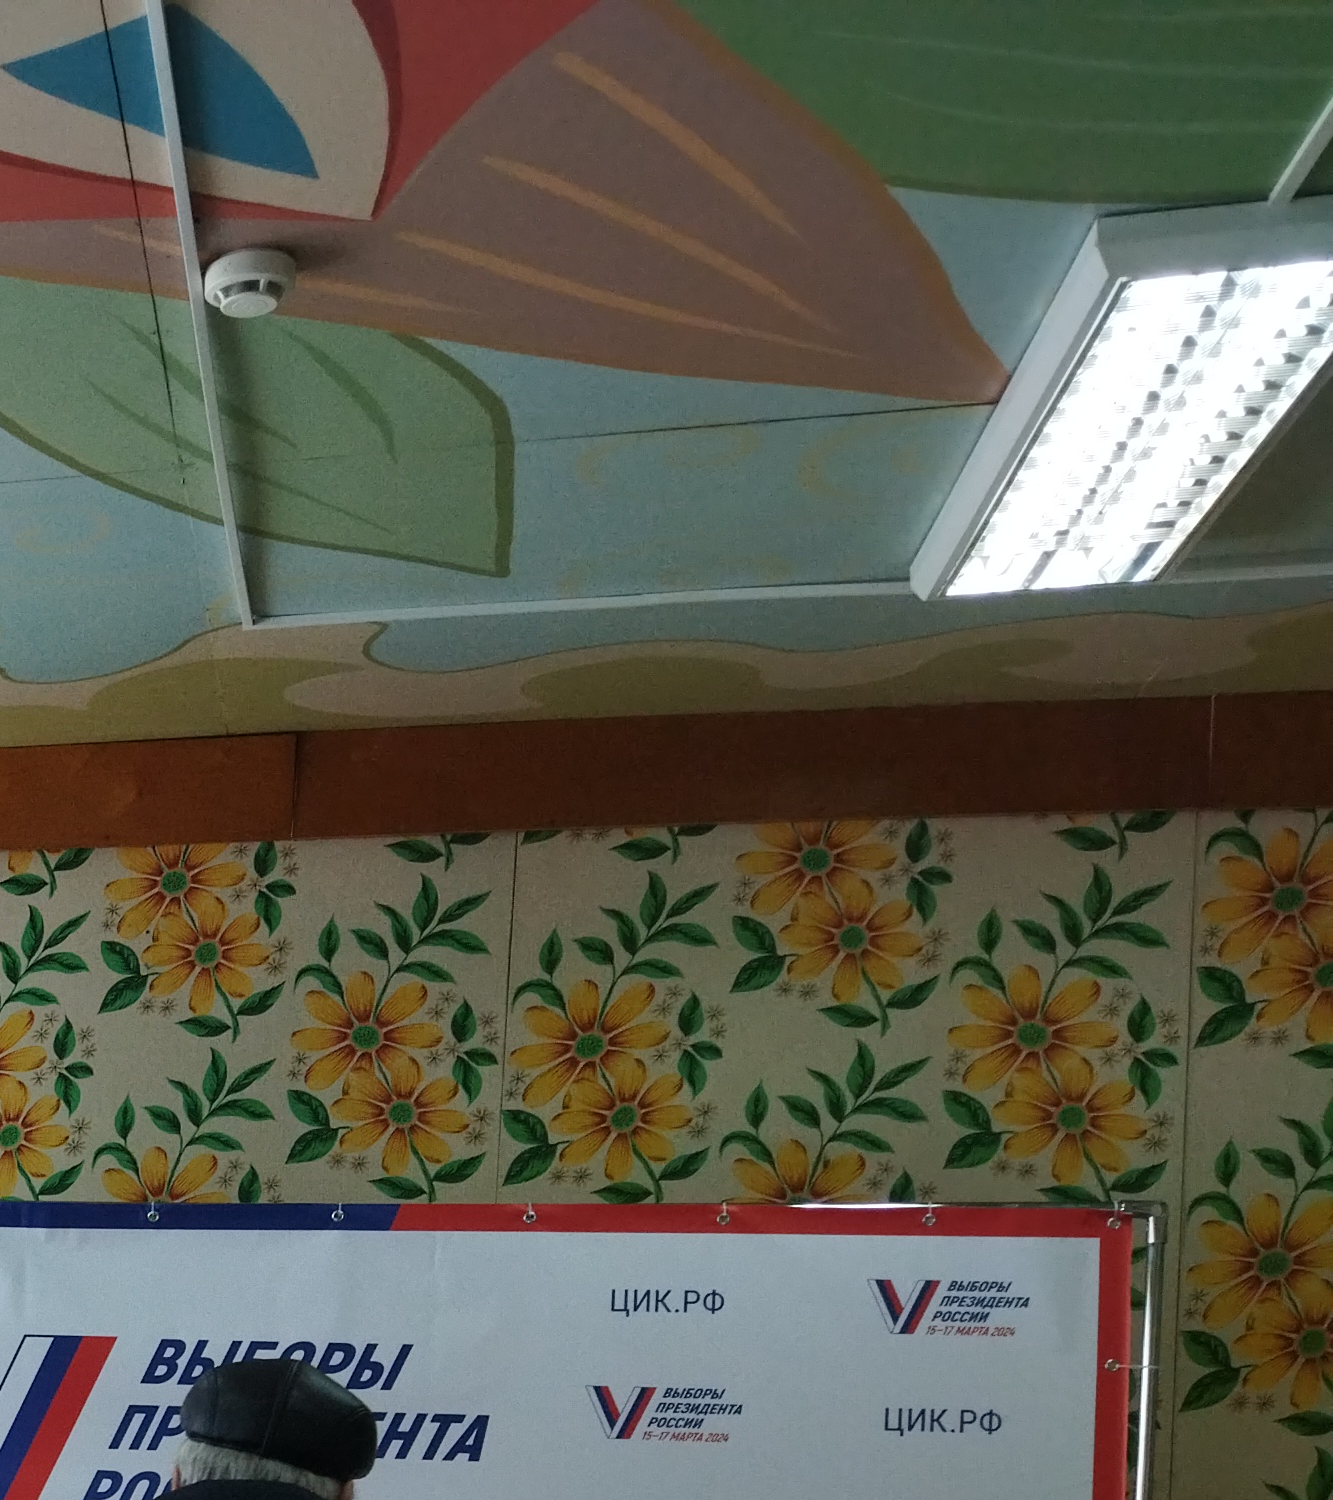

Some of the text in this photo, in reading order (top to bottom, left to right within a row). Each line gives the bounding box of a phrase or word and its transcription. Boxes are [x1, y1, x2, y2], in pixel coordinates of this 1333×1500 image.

[947, 1281, 1013, 1292] ВЫБОРЫ
[610, 1288, 725, 1318] ЦИК.РФ
[939, 1296, 1031, 1309] ПРЕЗИДЕНТА
[931, 1311, 990, 1323] РОССИИ
[955, 1326, 989, 1336] МАРТА
[991, 1327, 1015, 1337] 2024
[663, 1388, 726, 1400] ВЫБОРЫ
[655, 1402, 743, 1416] ПРЕЗИДЕНТА
[647, 1417, 705, 1430] РОССИИ
[884, 1407, 1002, 1437] ЦИК.РФ
[108, 1405, 490, 1462] ПРНТА
[669, 1432, 703, 1443] МАРТА
[705, 1432, 729, 1443] 2024
